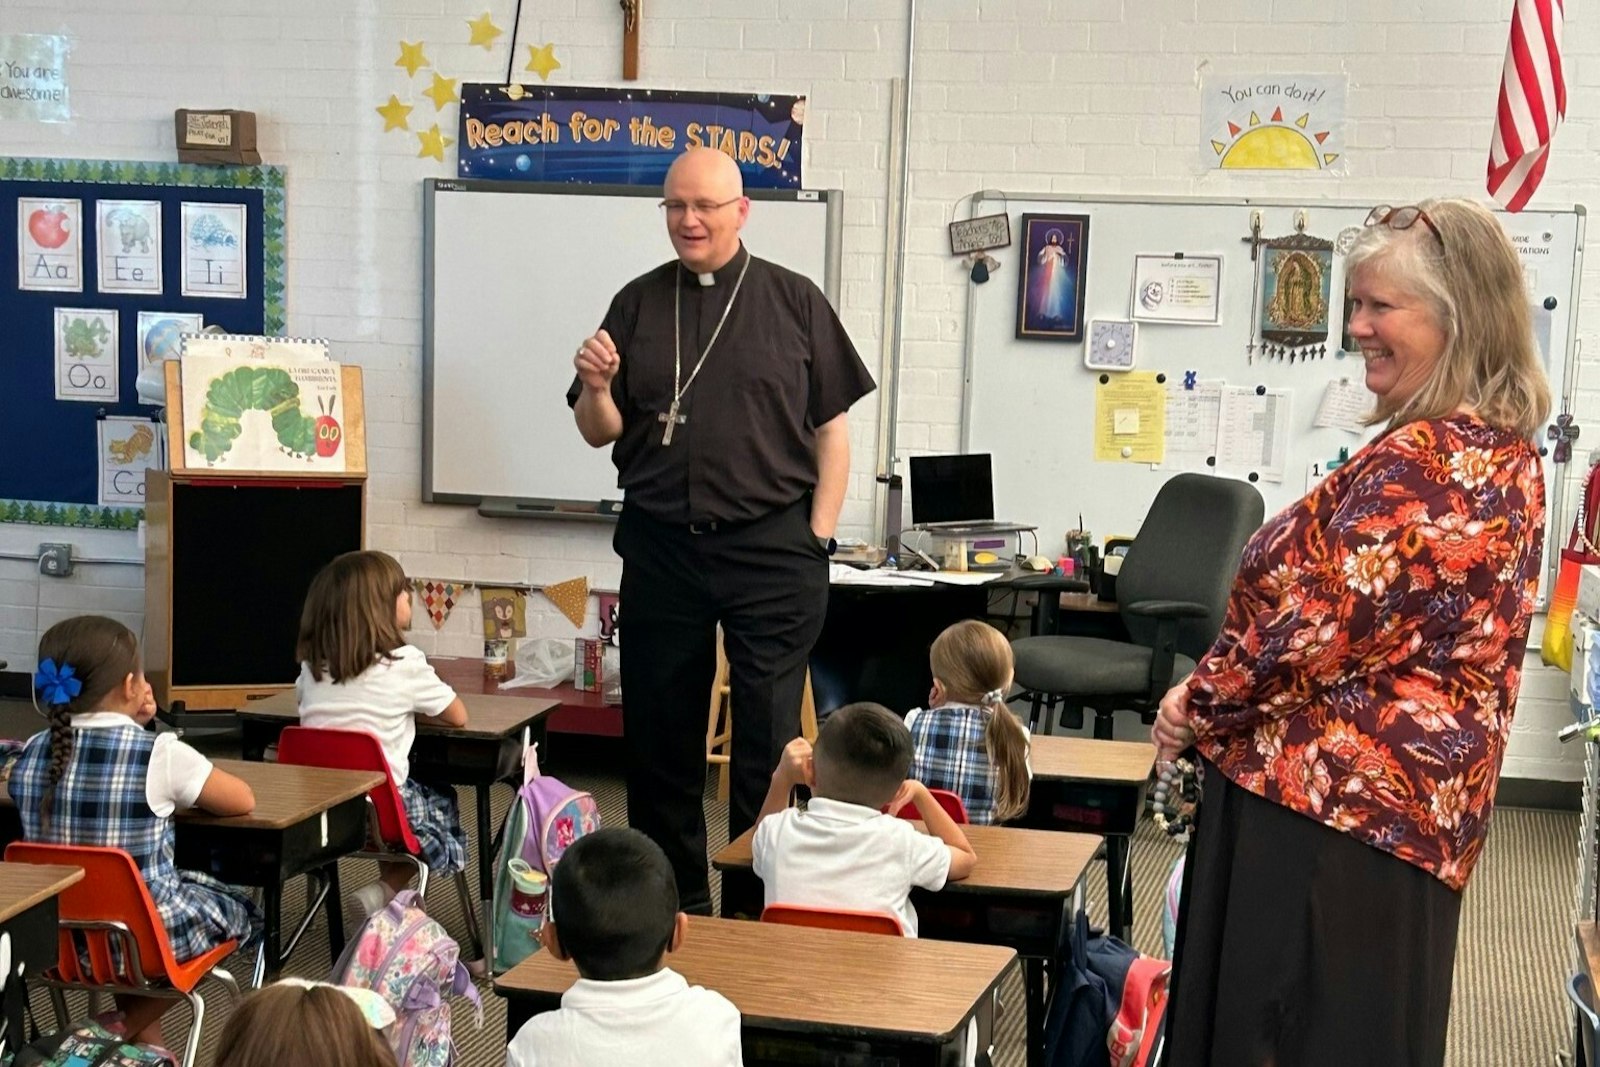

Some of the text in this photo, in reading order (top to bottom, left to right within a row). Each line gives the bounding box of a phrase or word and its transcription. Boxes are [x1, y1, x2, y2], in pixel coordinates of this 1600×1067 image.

[5, 60, 60, 80] You are
[1221, 82, 1326, 104] You can do it!
[465, 110, 792, 170] Reach for the STARS!
[33, 254, 68, 279] Aa
[115, 256, 144, 281] Ee
[205, 259, 223, 285] Ii
[68, 364, 106, 389] Oo
[1313, 463, 1323, 477] 1.
